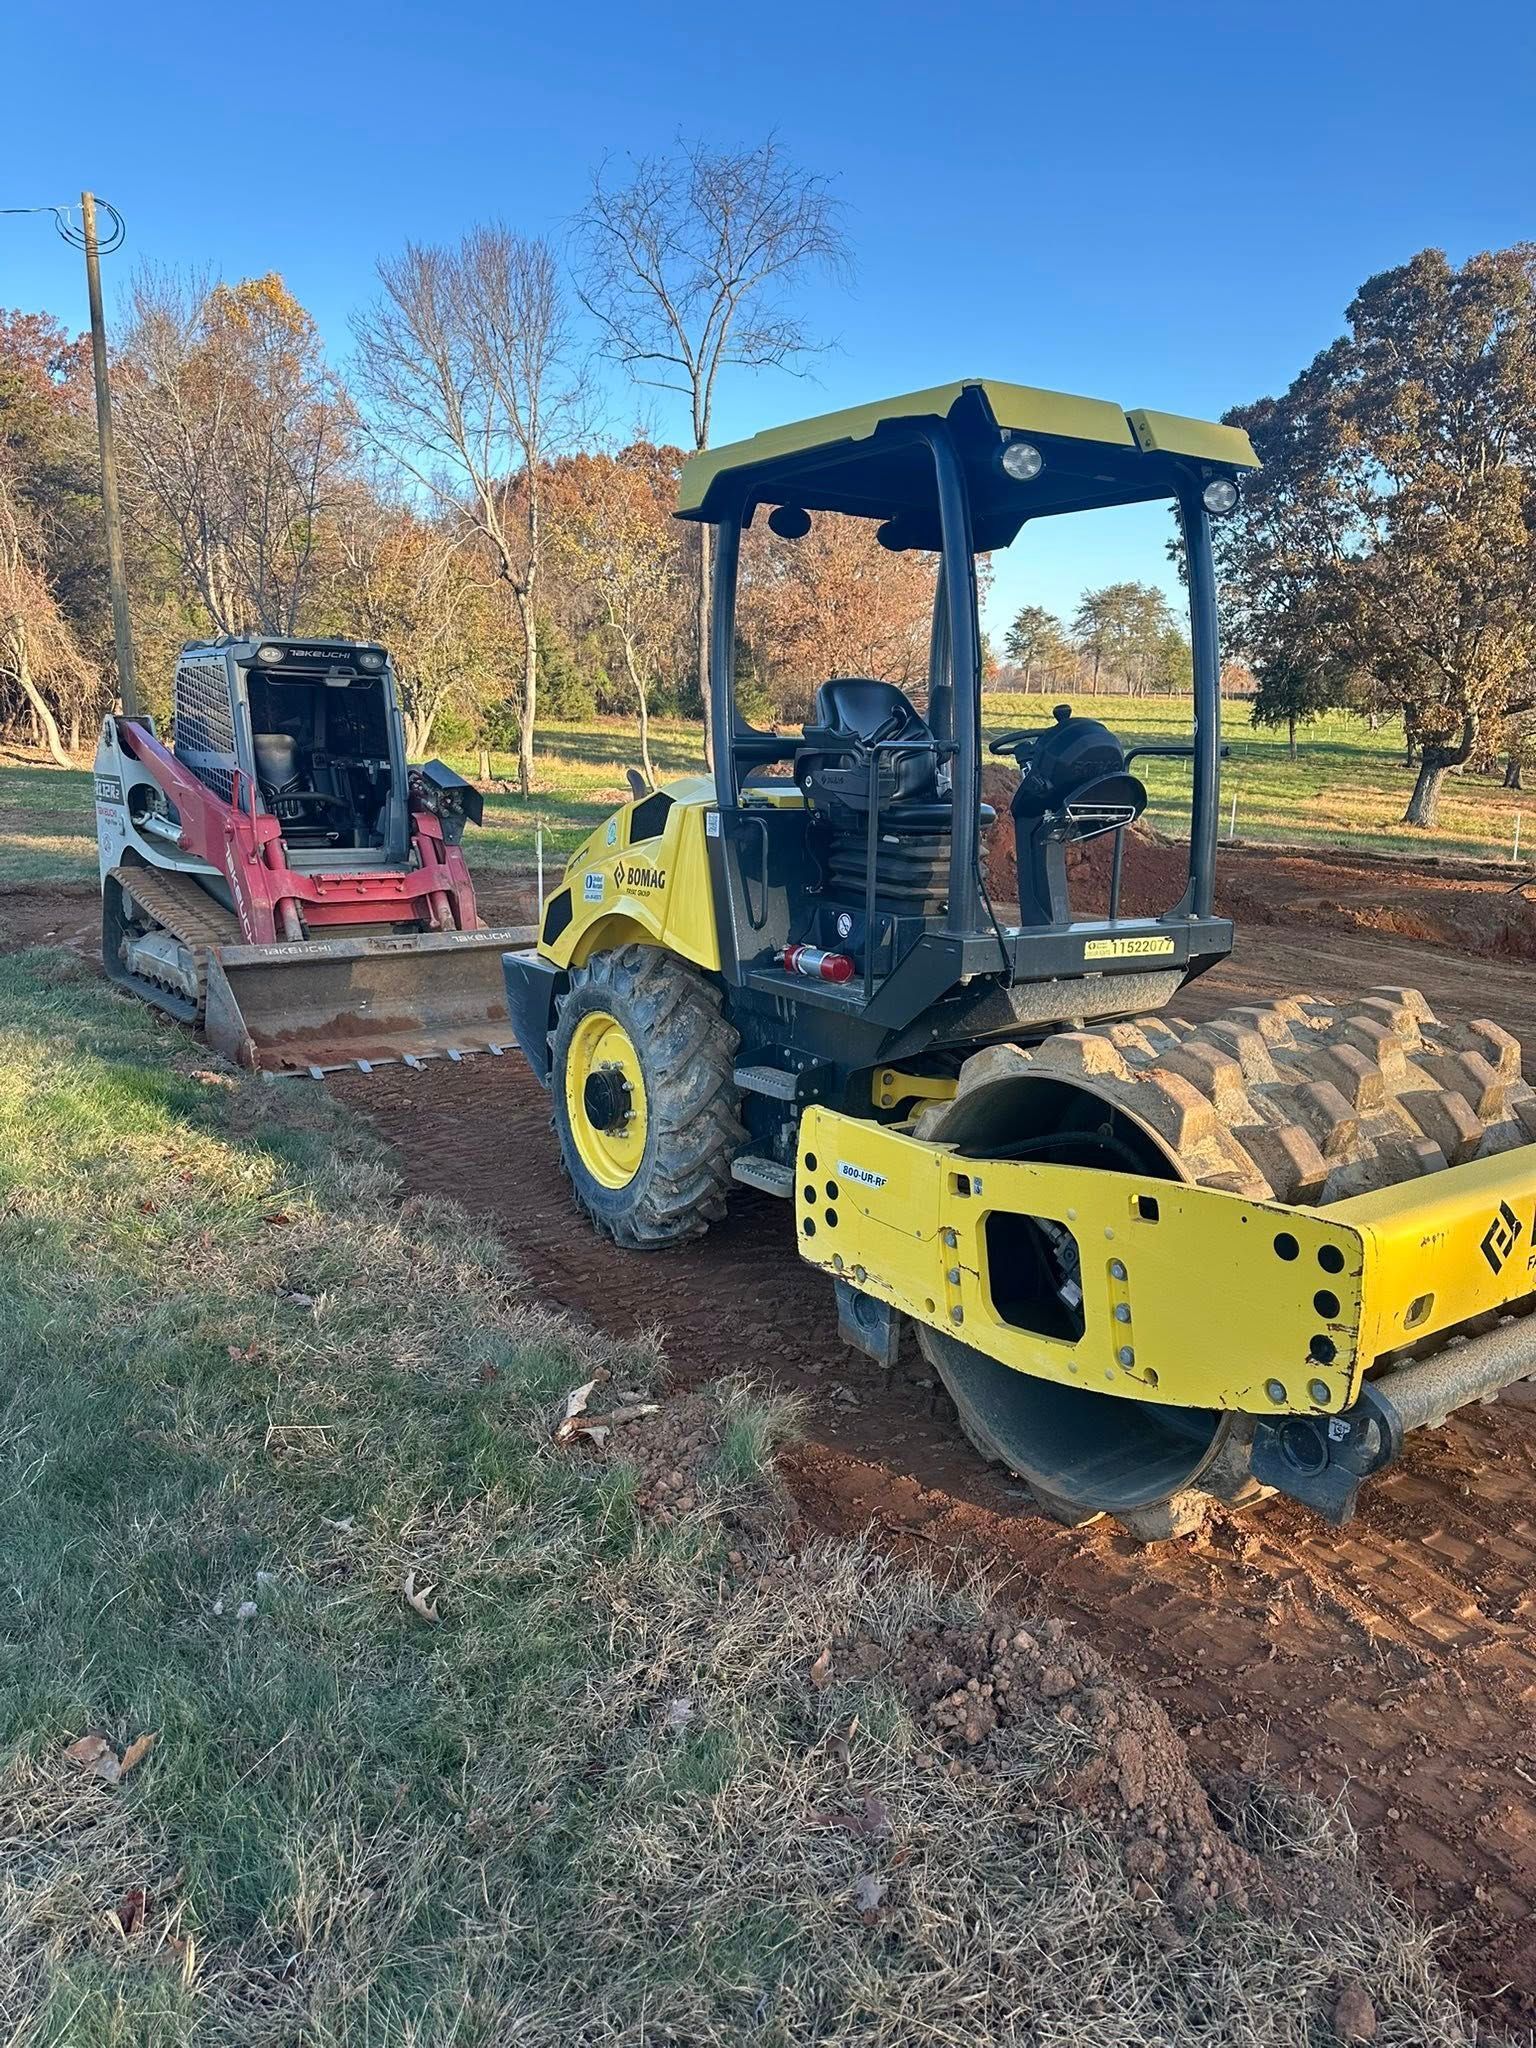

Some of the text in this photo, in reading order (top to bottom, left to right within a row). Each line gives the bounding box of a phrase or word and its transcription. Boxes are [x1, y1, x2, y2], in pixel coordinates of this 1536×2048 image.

[627, 867, 666, 889] BOMAG
[226, 841, 254, 946] TAKEUCH
[1112, 939, 1172, 954] 11522077
